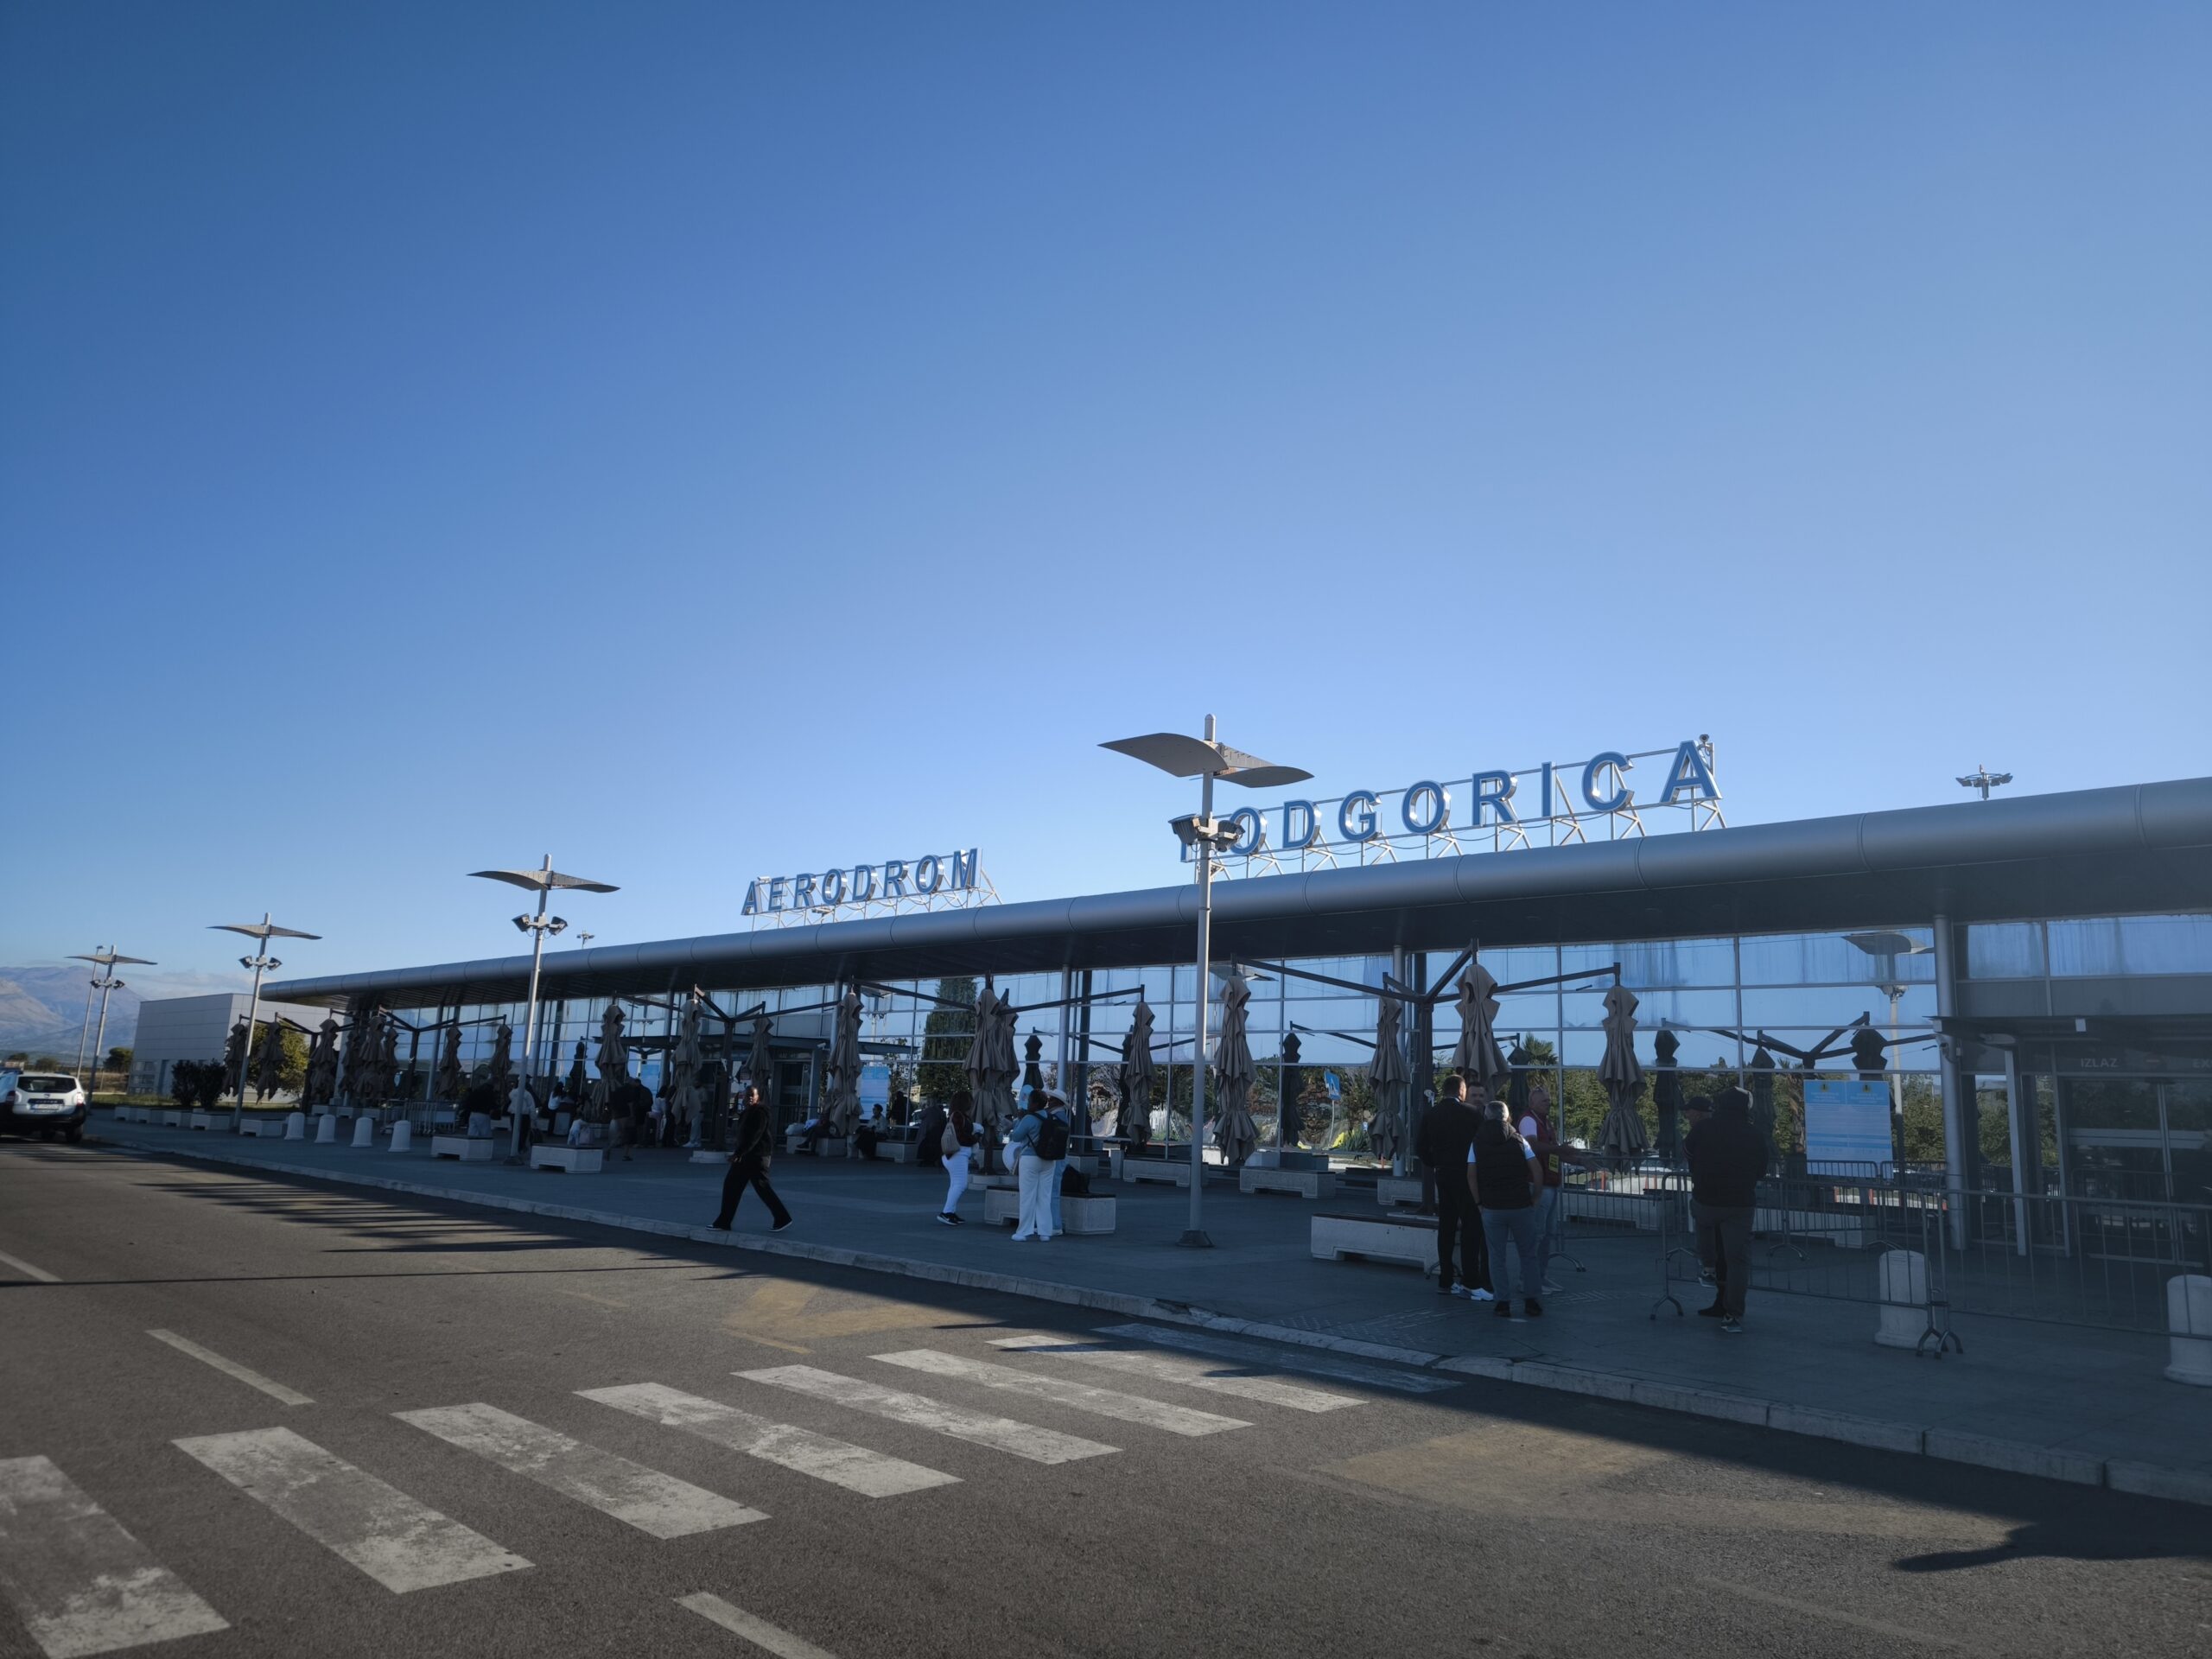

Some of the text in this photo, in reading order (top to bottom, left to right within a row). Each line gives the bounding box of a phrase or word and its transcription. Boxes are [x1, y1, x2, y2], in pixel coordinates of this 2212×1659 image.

[741, 741, 1721, 915] AERODROM ODGORICA
[2080, 1058, 2119, 1069] IZLAZ
